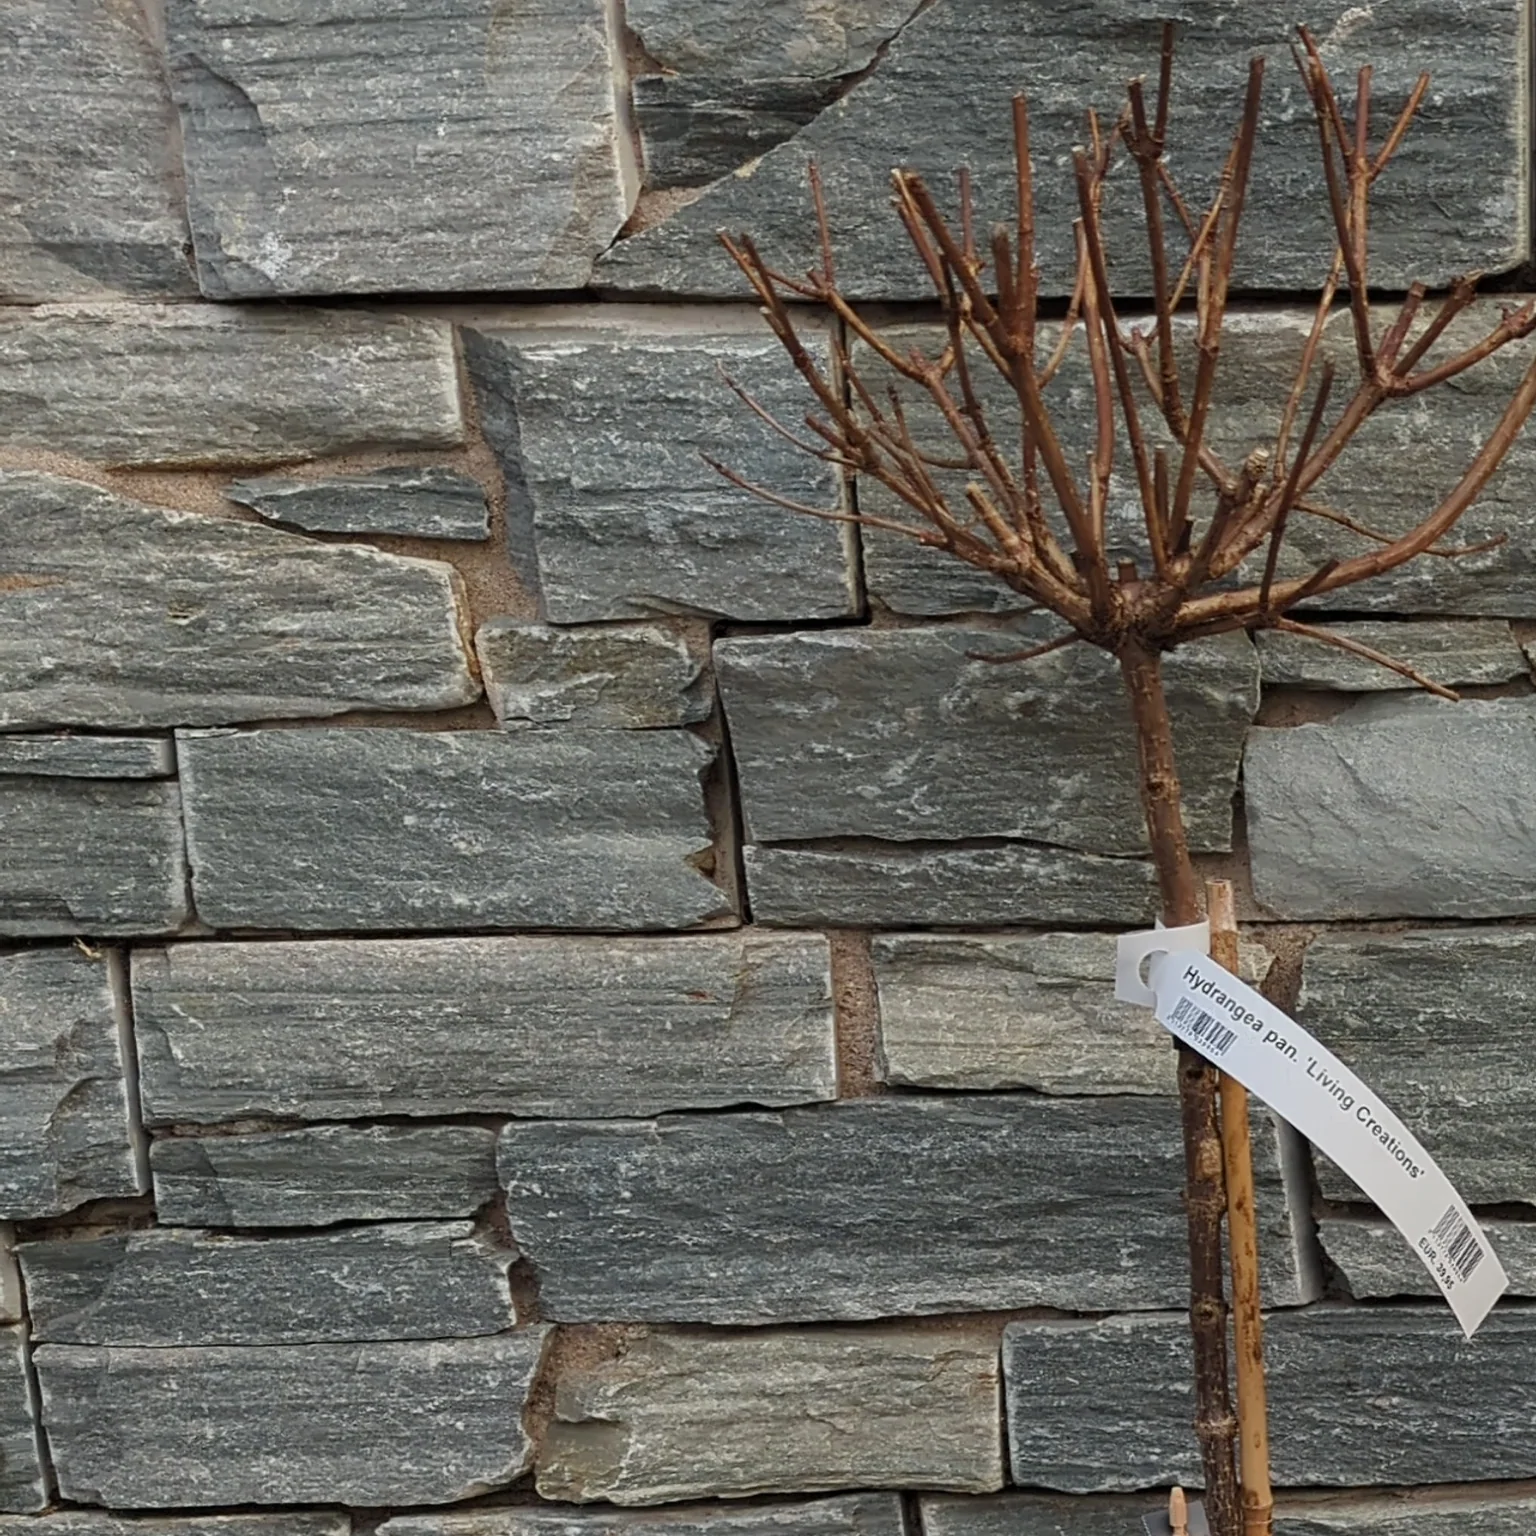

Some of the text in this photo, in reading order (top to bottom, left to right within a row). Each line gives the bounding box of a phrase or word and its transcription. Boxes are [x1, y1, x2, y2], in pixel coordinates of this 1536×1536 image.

[1182, 965, 1264, 1032] Hydrangea
[1262, 1028, 1299, 1064] pan.
[1305, 1056, 1354, 1111] 'Living
[1356, 1106, 1425, 1180] Creations'
